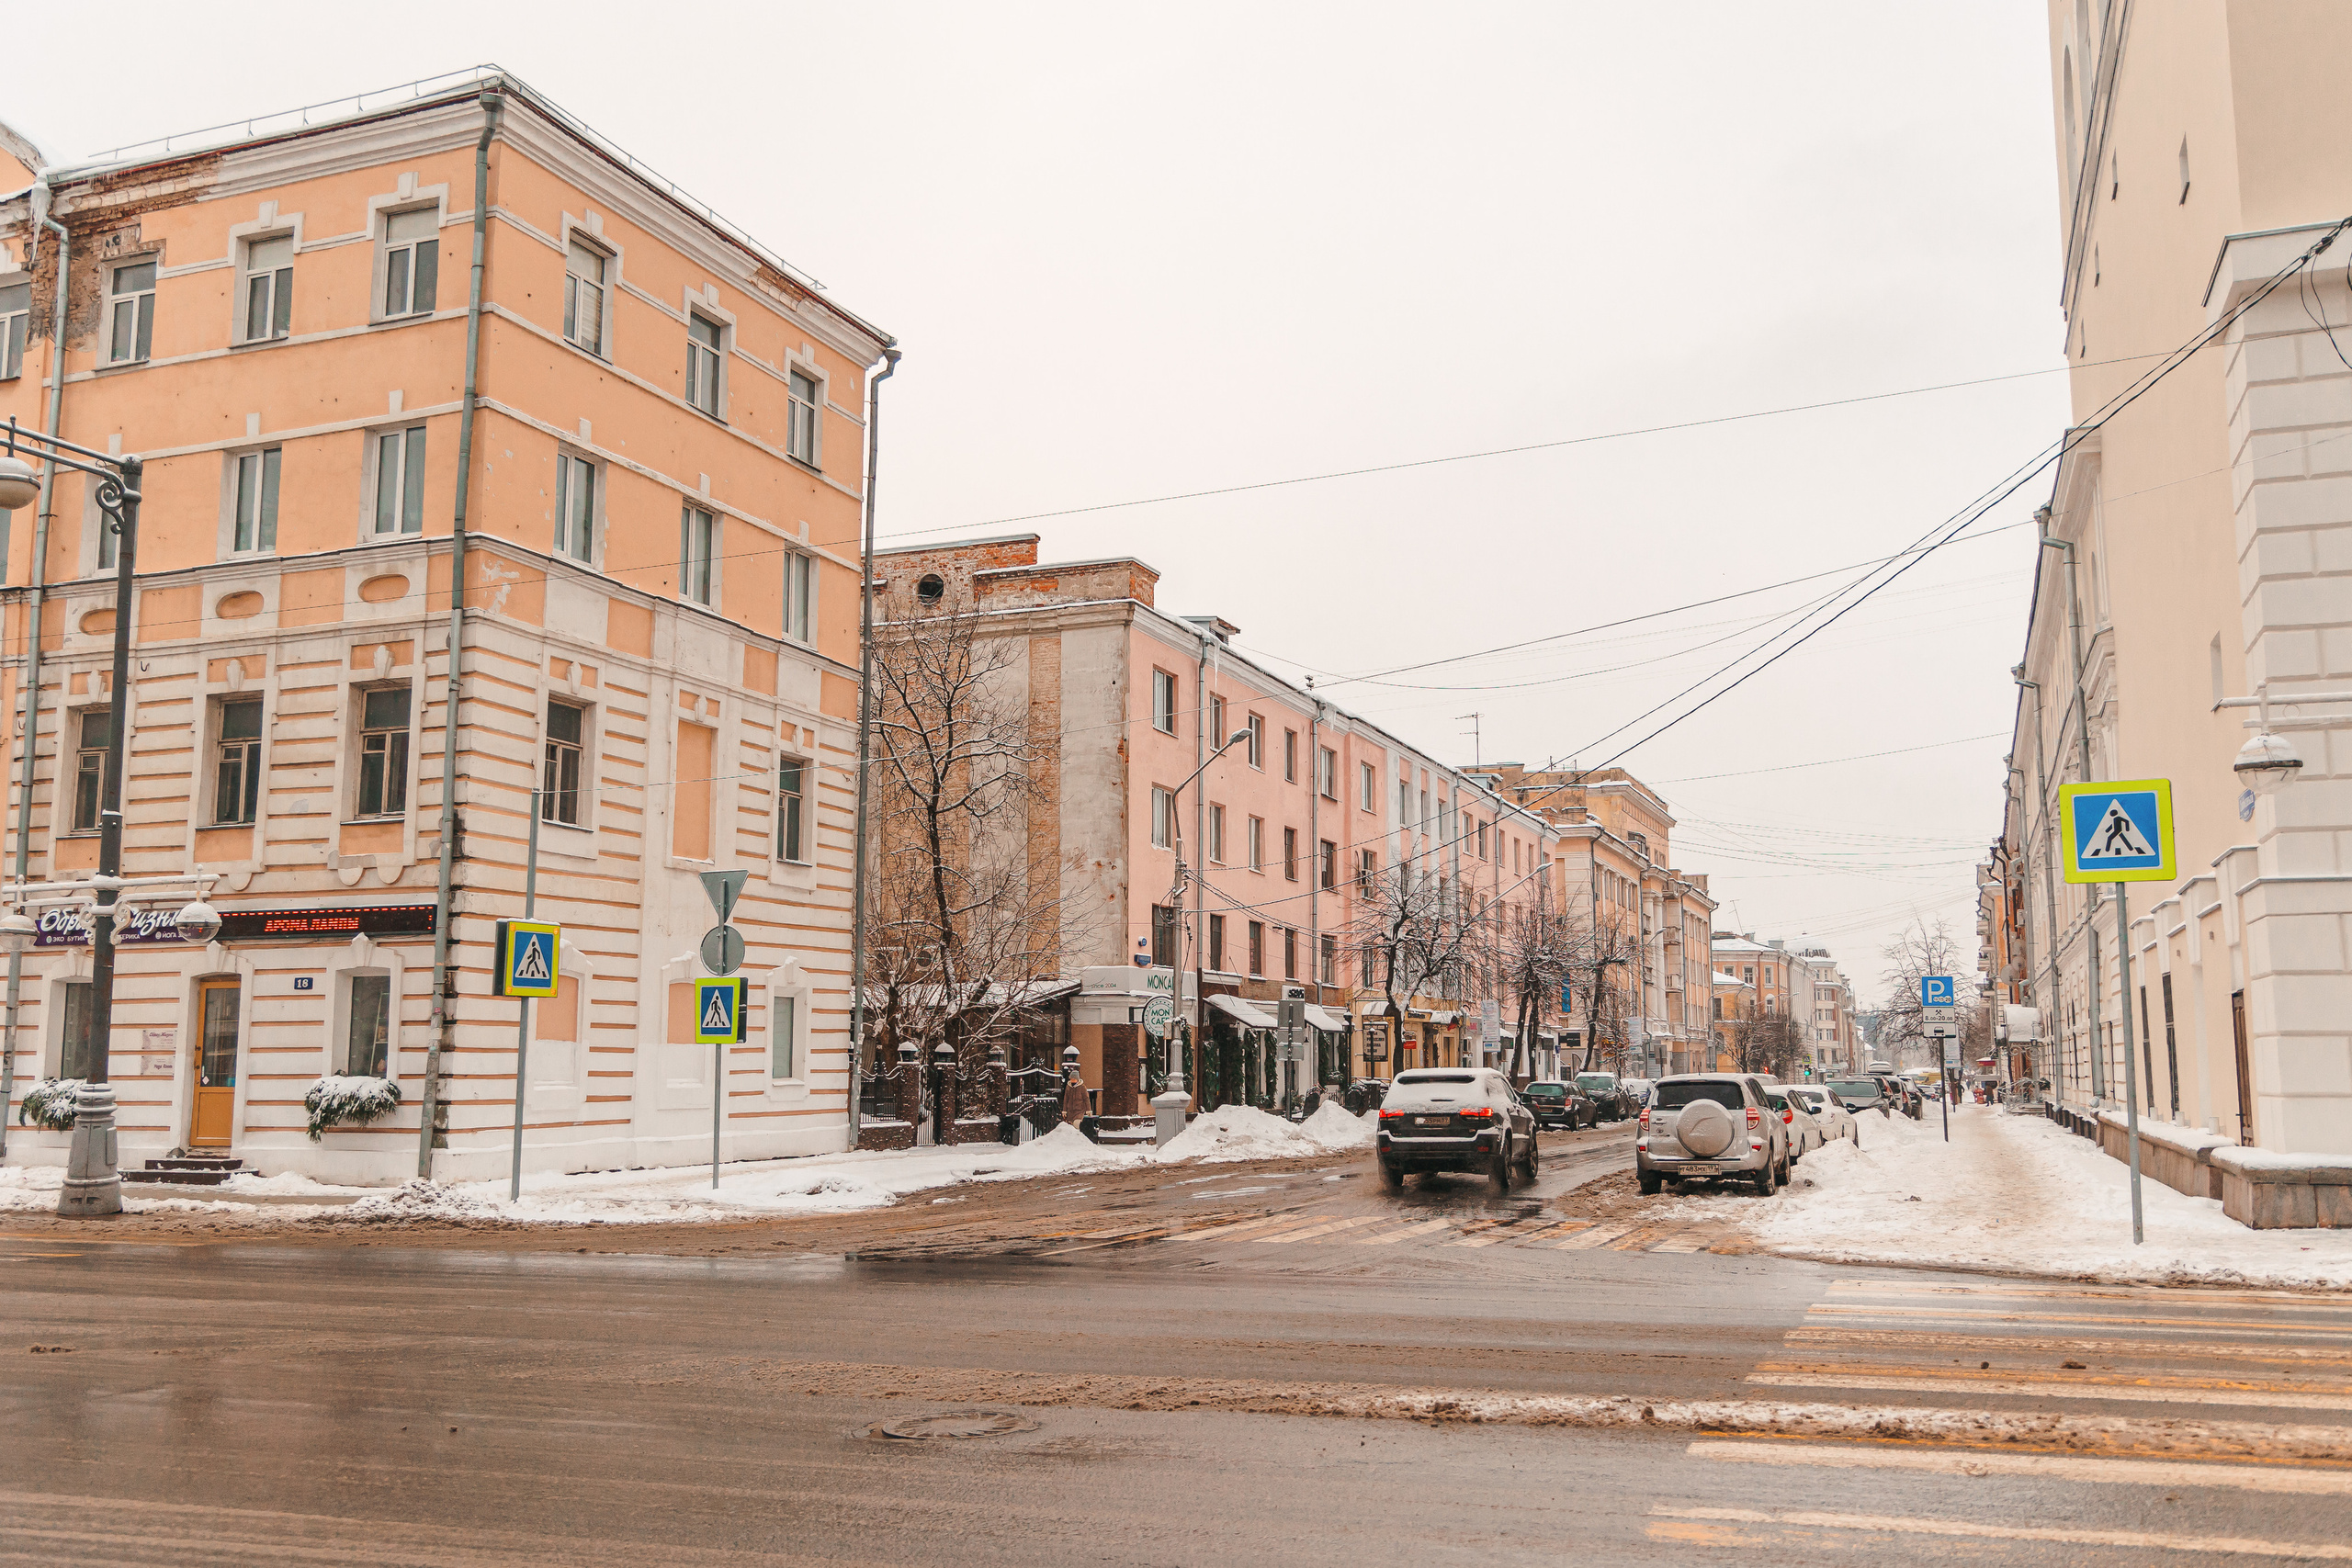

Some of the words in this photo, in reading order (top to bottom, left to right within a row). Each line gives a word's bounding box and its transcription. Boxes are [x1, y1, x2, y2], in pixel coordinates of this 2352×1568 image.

[265, 919, 309, 931] АРОМА
[310, 918, 359, 931] ЛАМПЫ
[297, 979, 309, 987] 18
[1928, 980, 1945, 1003] P
[1151, 1009, 1170, 1017] MON
